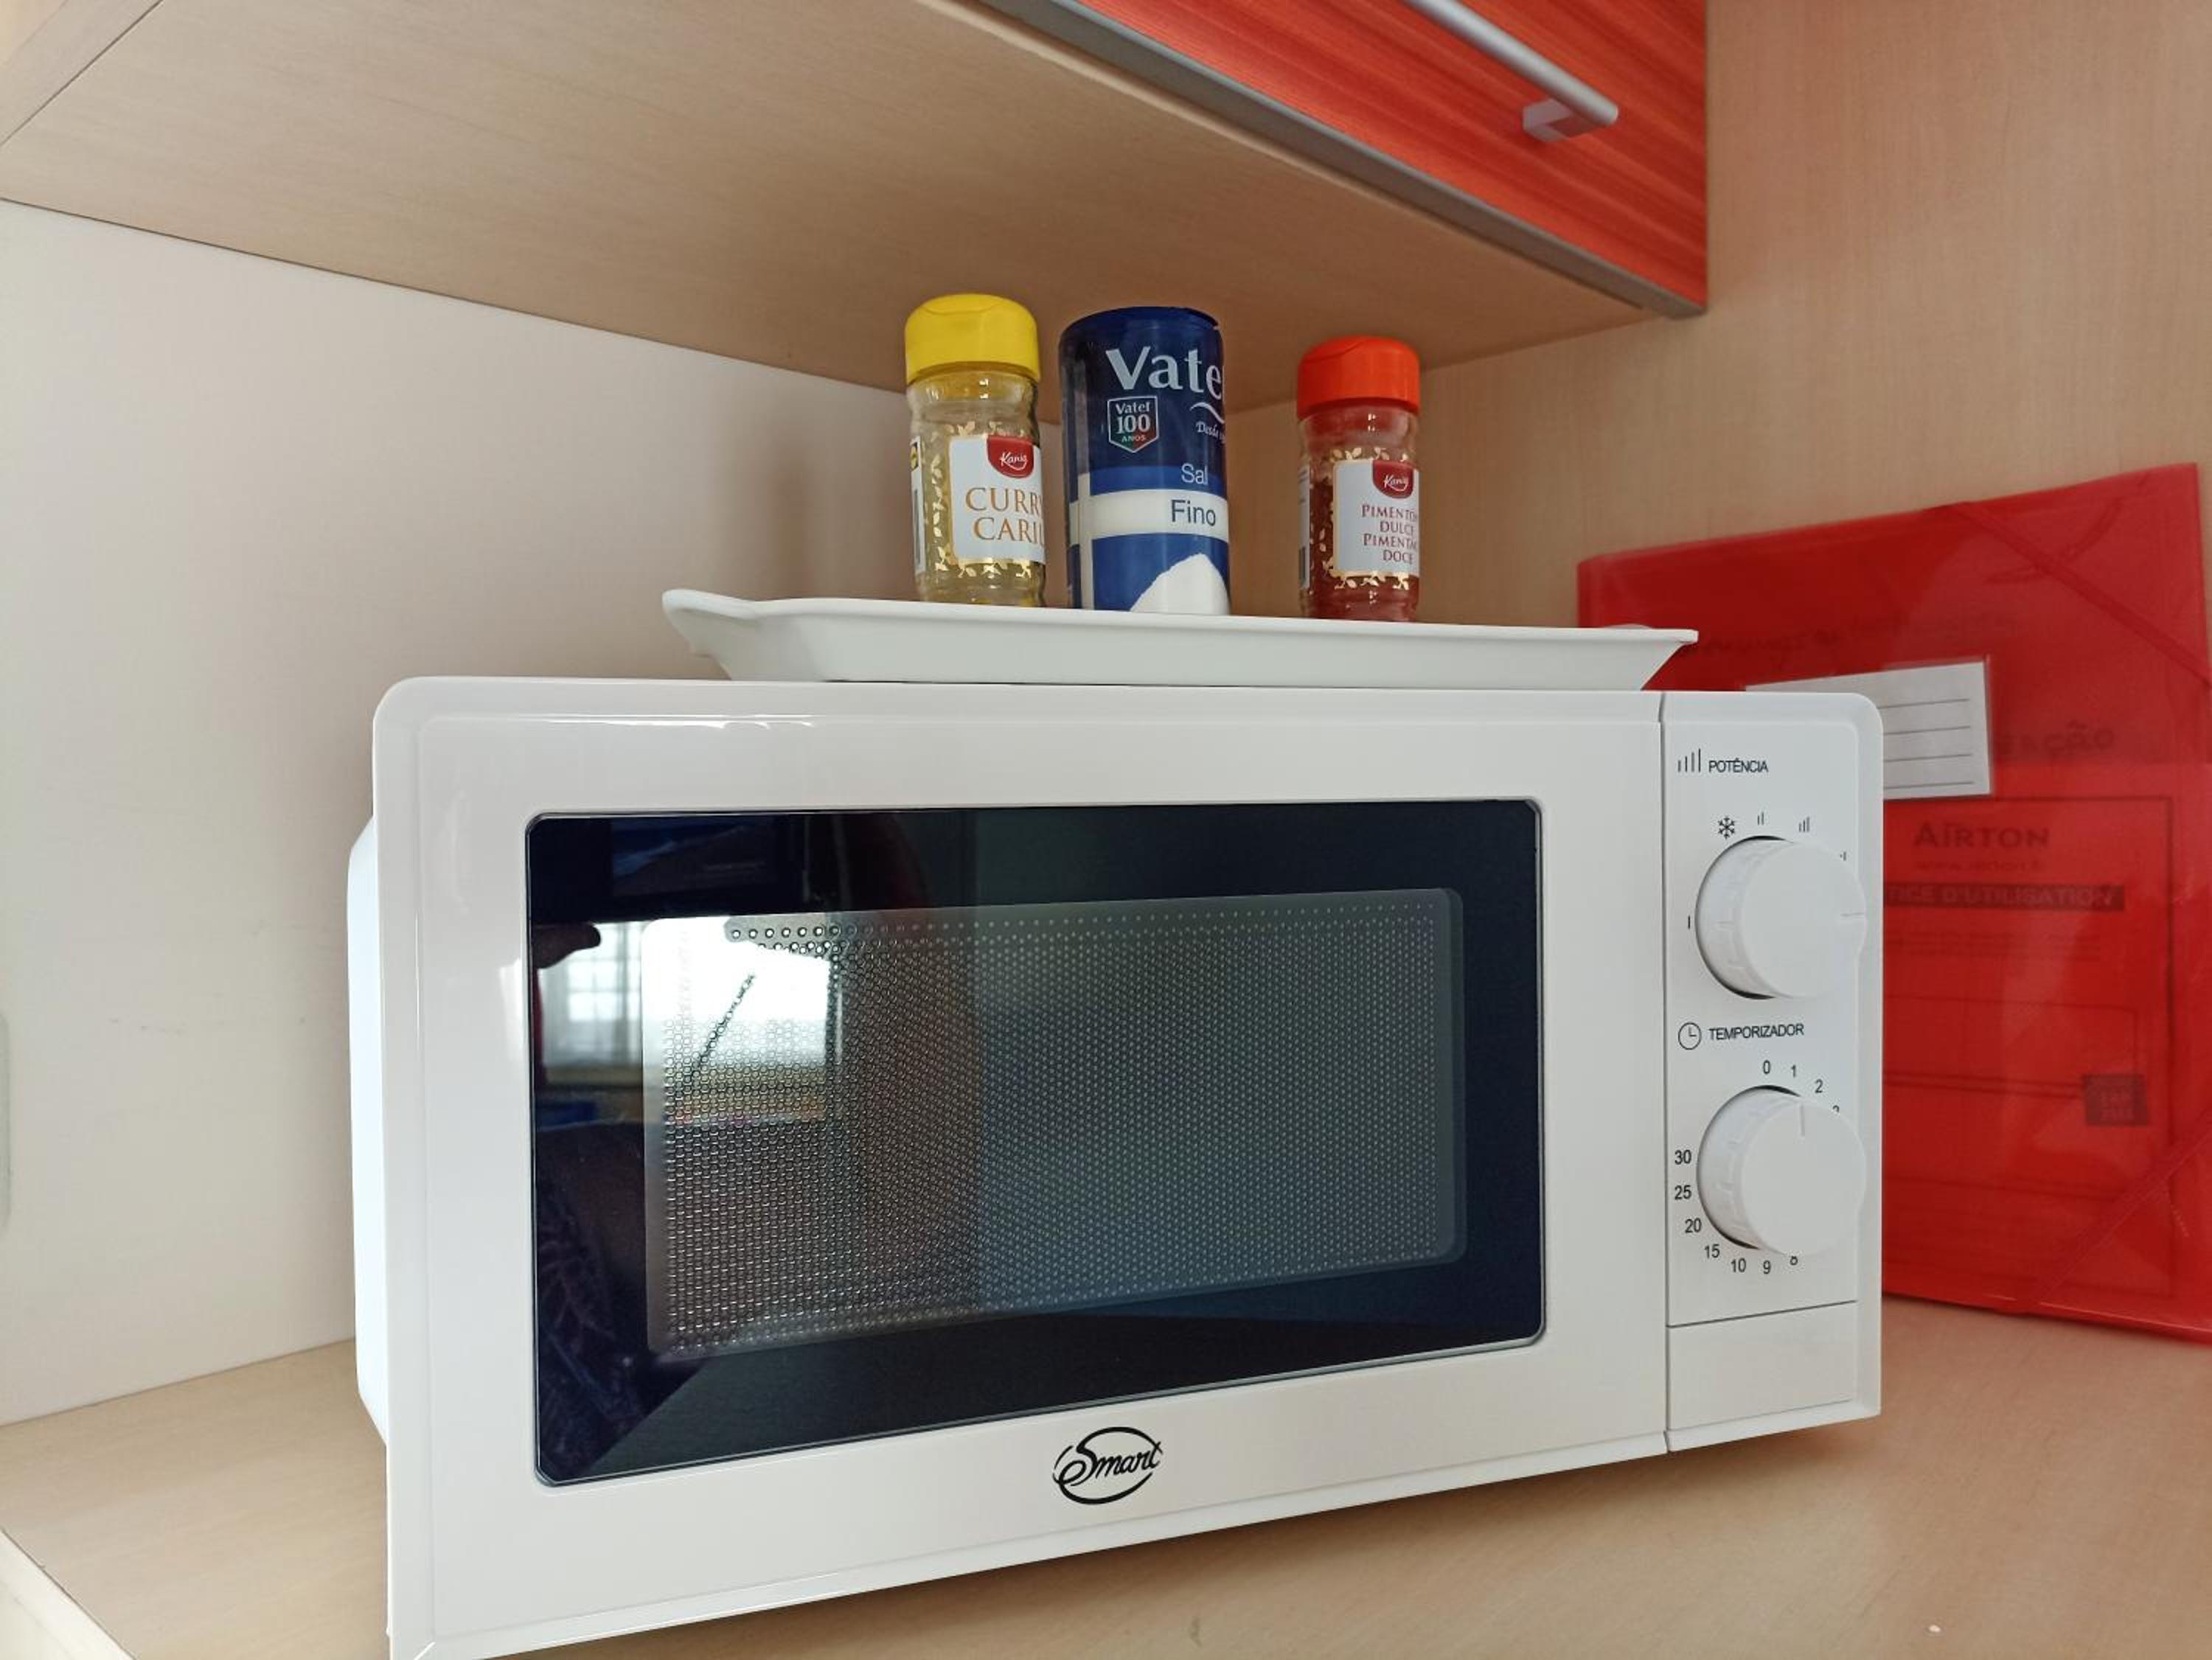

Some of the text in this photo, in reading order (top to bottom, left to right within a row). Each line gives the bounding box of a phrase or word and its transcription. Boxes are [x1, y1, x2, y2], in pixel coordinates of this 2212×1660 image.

[1115, 401, 1151, 415] Vatel
[1116, 414, 1151, 434] 100
[1181, 462, 1208, 485] Sal
[1171, 499, 1216, 526] Fino
[1382, 549, 1413, 565] DOCE
[1708, 758, 1769, 773] POTÊNCIA
[1885, 885, 1935, 902] TICE
[1708, 1023, 1805, 1040] TEMPORIZADOR
[1762, 1060, 1771, 1074] 0
[1790, 1064, 1798, 1077] 1
[1815, 1079, 1823, 1093] 2
[1674, 1150, 1692, 1165] 30
[1674, 1185, 1692, 1200] 25
[1685, 1218, 1702, 1233] 20
[1704, 1244, 1720, 1258] 15
[1731, 1258, 1747, 1273] 10
[1763, 1260, 1771, 1274] 9
[1057, 1428, 1163, 1488] Smart
